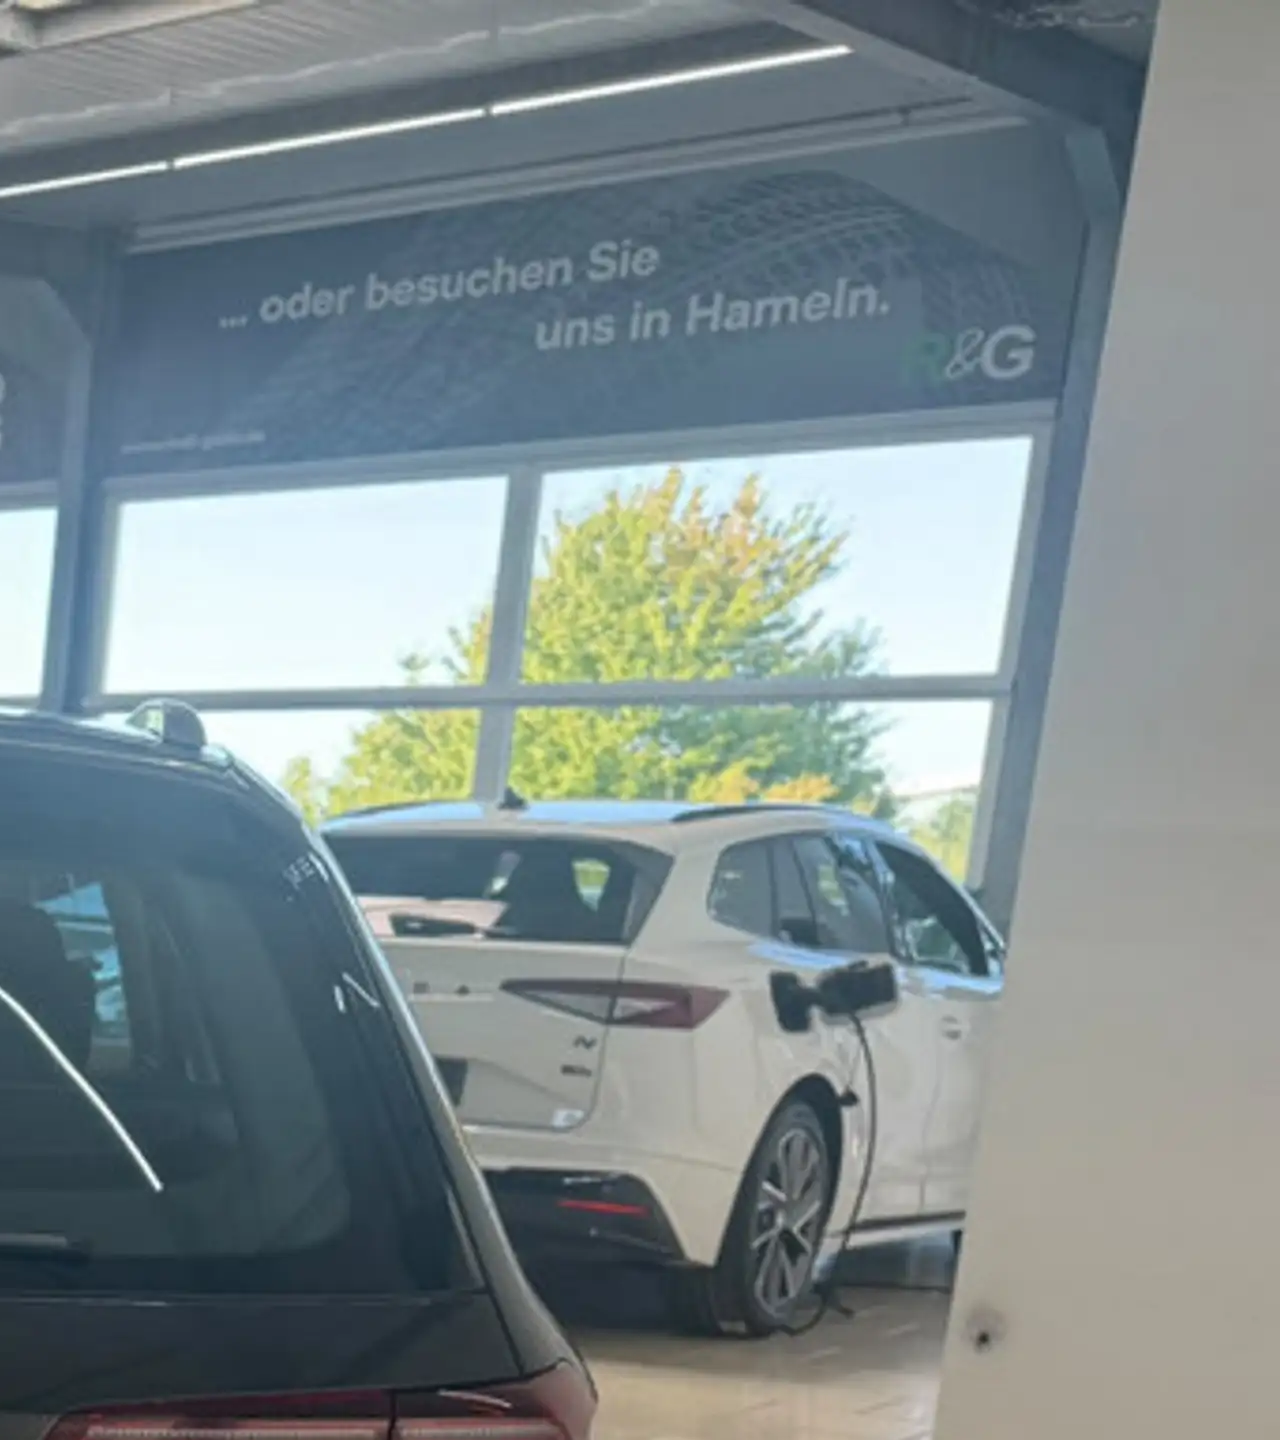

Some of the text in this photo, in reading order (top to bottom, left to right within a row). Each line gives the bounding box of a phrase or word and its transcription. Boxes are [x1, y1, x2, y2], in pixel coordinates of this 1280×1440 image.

[260, 283, 354, 324] oder
[366, 255, 573, 310] besuchen
[587, 239, 660, 282] Sie
[535, 278, 892, 352] uns in Hameln.
